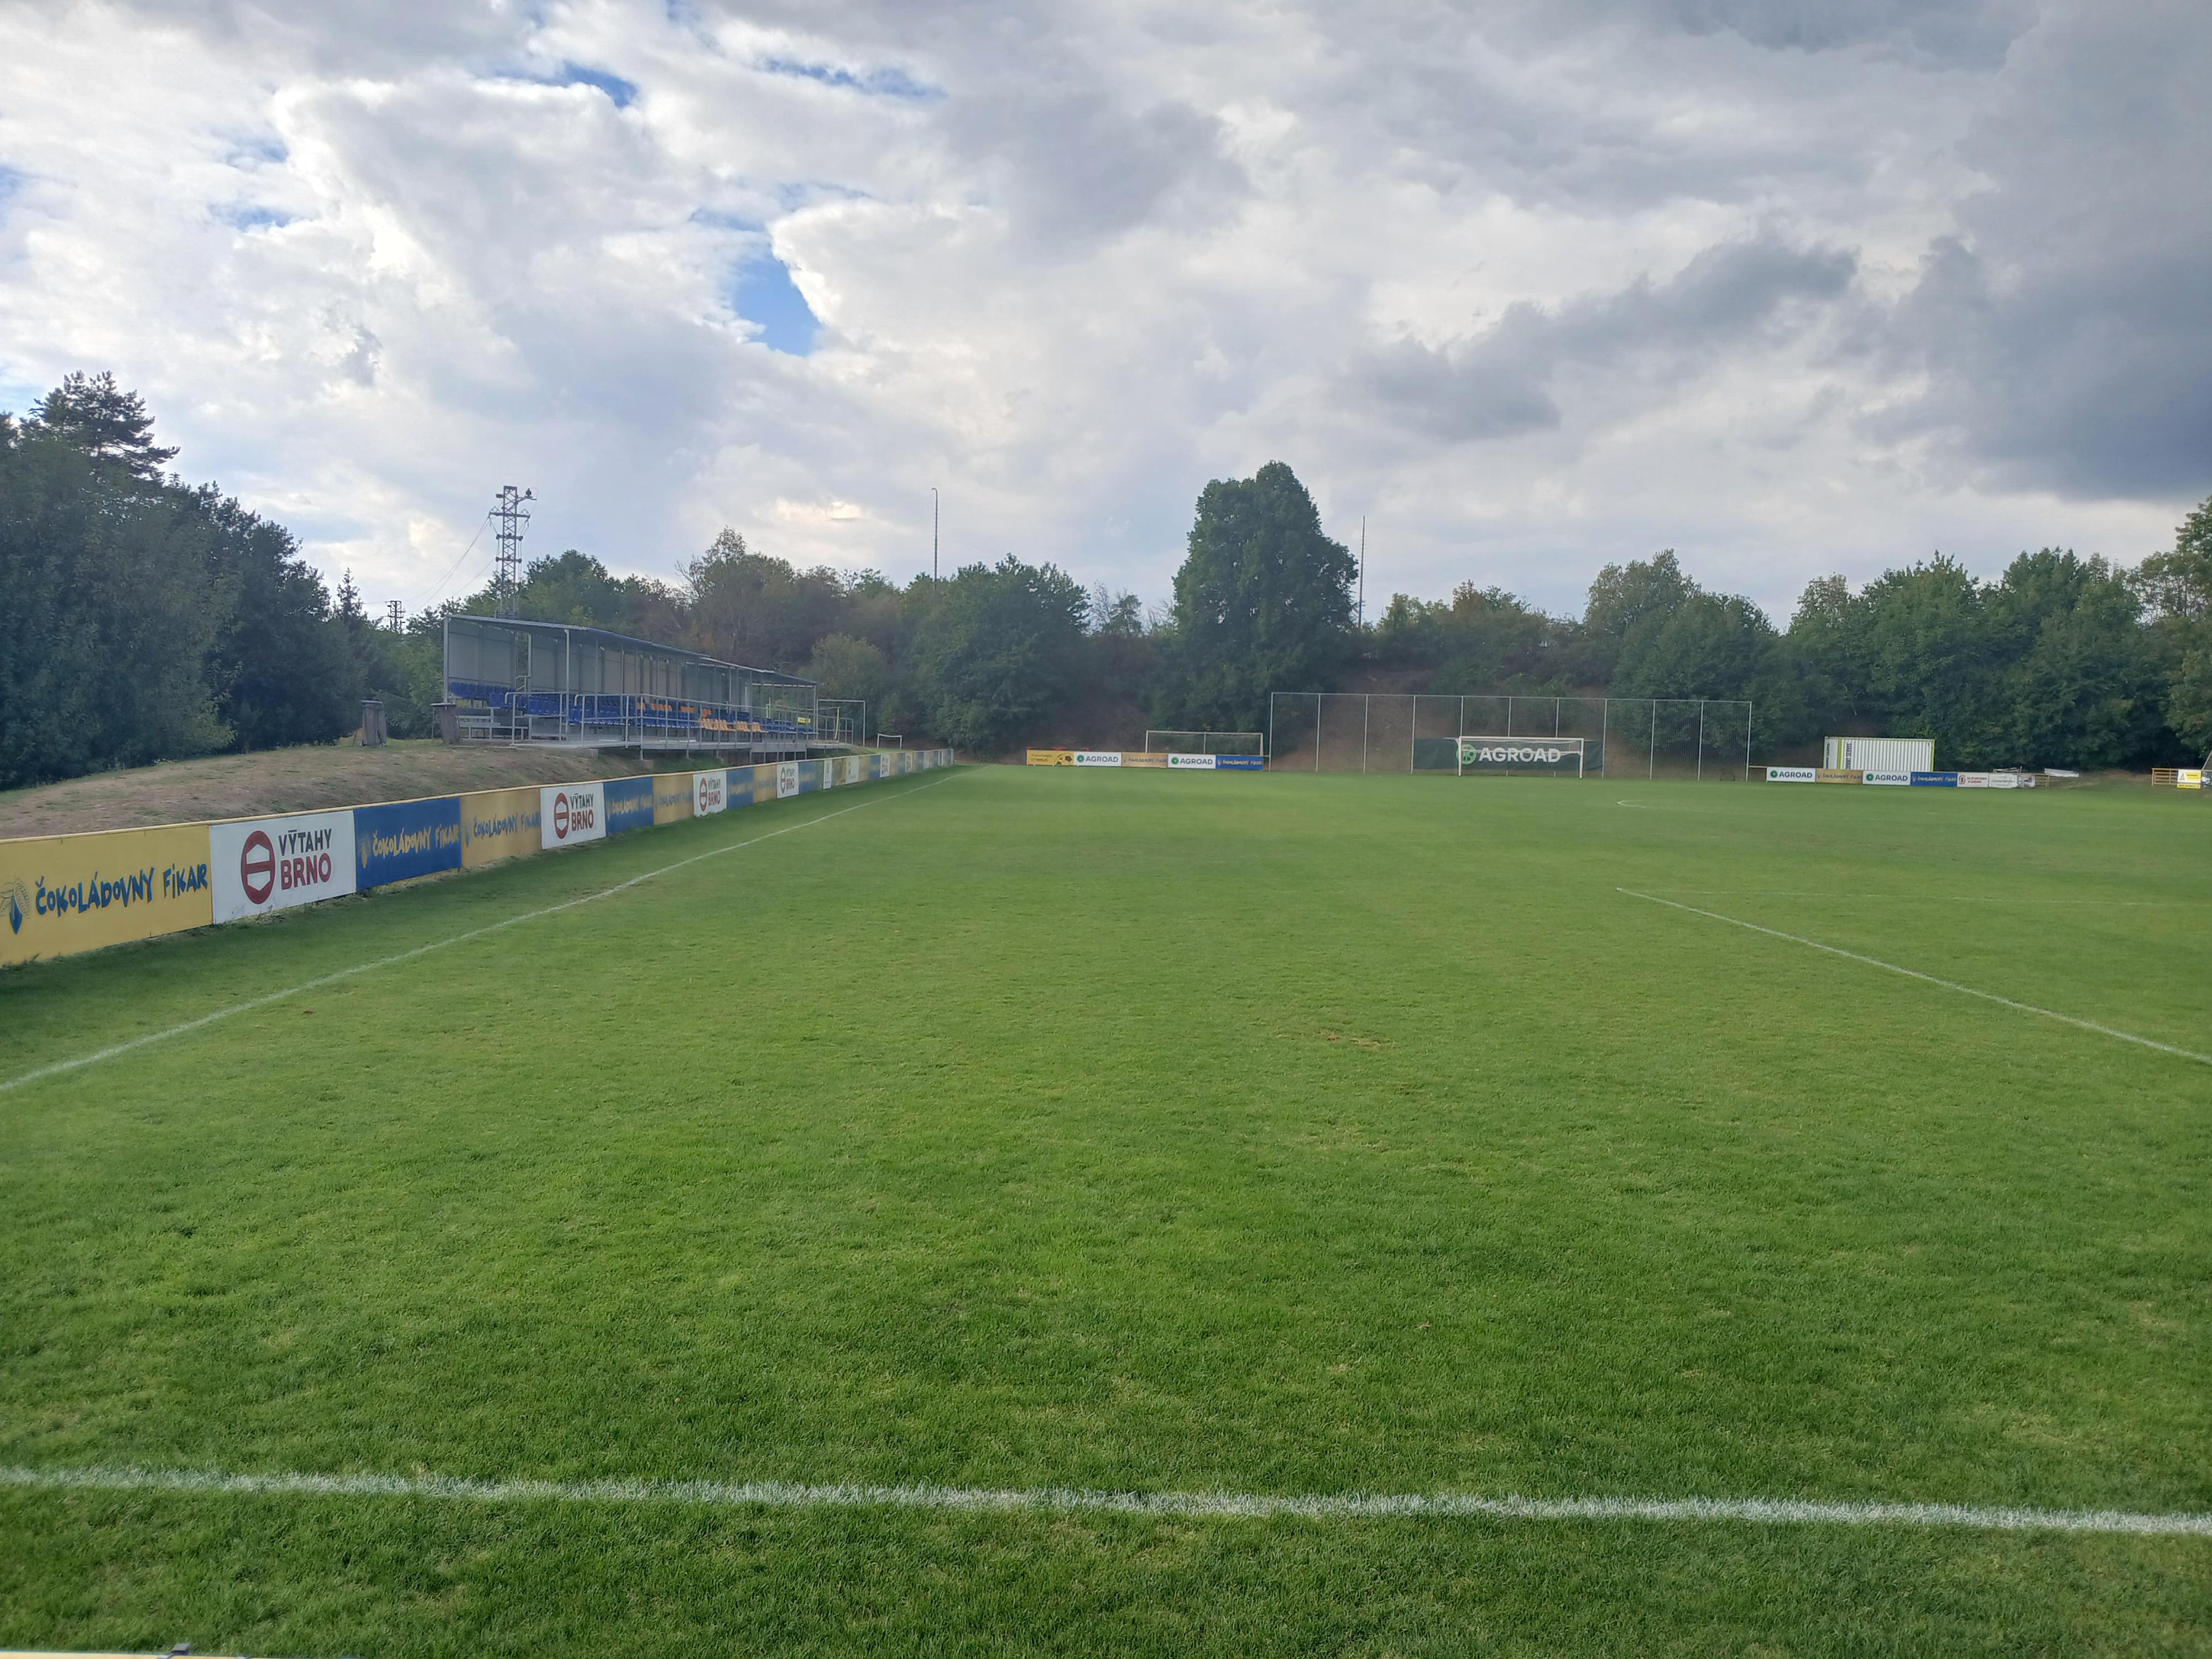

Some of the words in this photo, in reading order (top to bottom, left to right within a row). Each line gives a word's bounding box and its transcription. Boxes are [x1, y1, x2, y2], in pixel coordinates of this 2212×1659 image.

[1478, 747, 1561, 763] AGROAD
[571, 809, 594, 831] BRNO
[280, 853, 332, 890] BRNO
